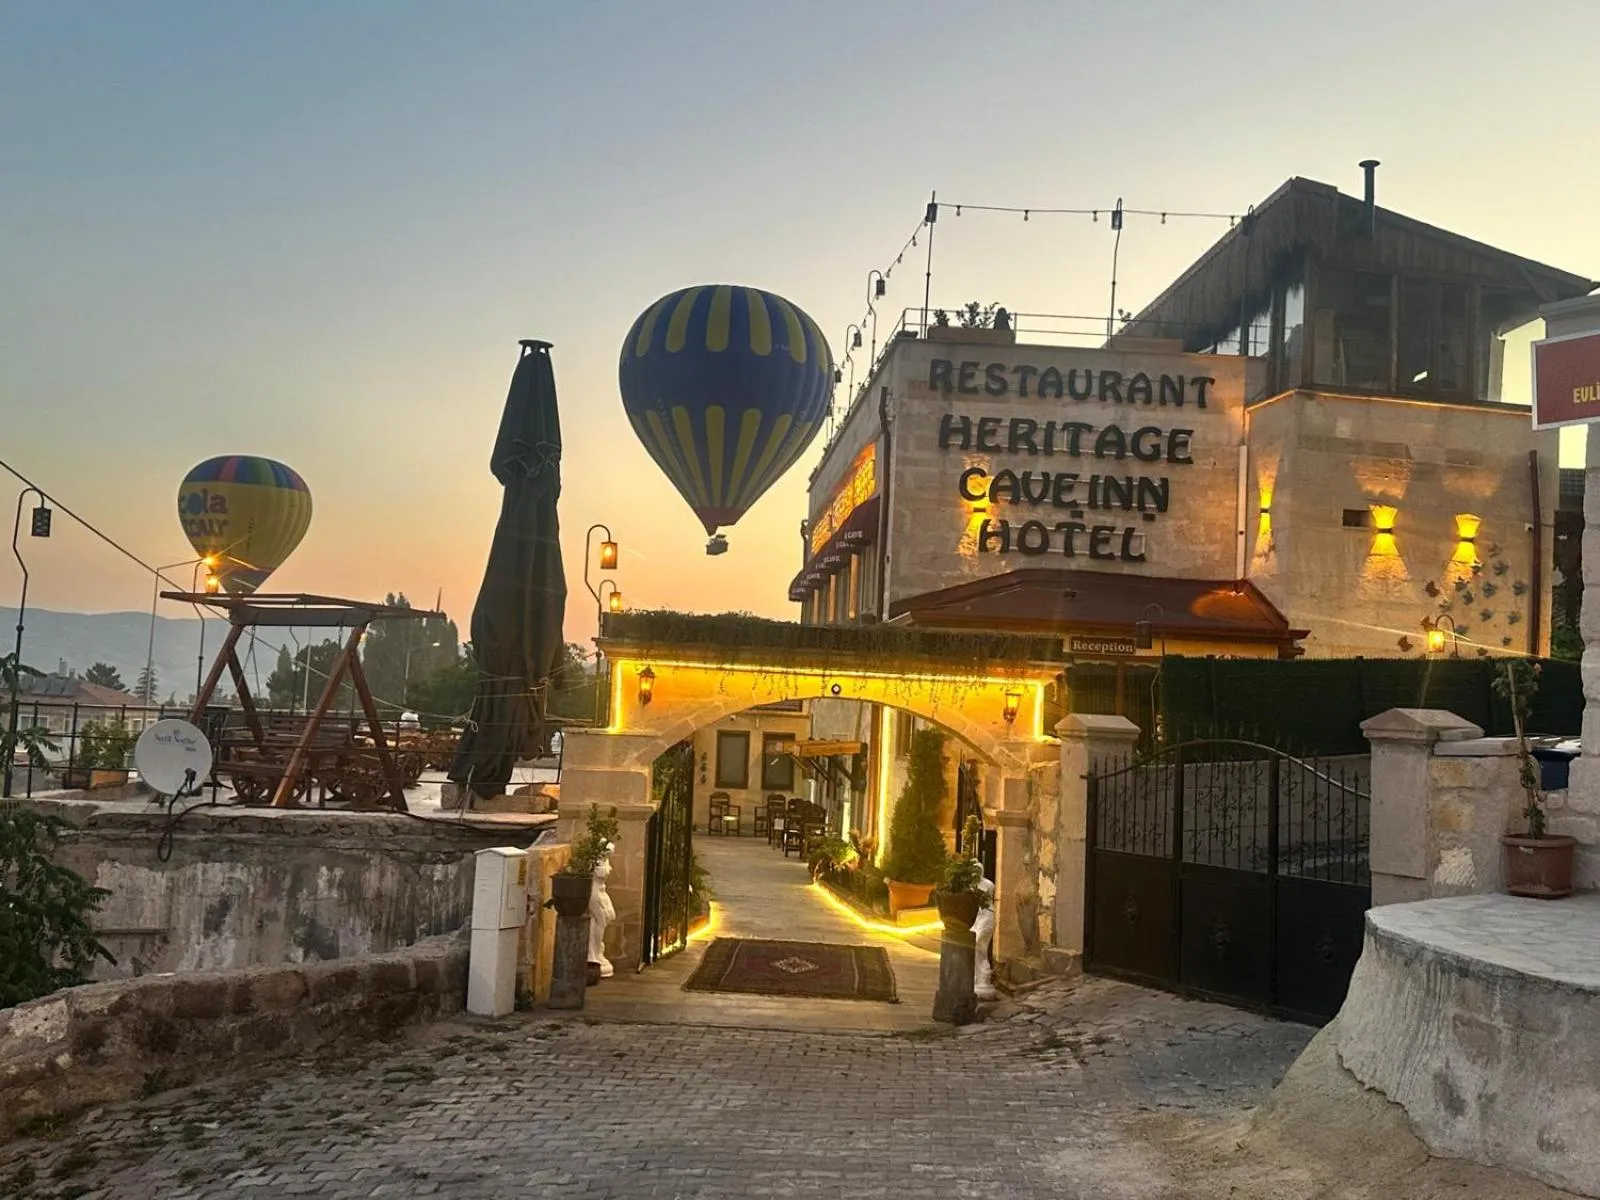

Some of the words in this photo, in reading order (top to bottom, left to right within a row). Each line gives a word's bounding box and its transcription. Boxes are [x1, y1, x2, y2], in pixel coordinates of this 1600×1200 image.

[929, 358, 1215, 408] RESTAURANT
[939, 413, 1194, 464] HERITAGE
[959, 468, 1079, 508] CAVE
[1089, 475, 1170, 513] INN
[978, 519, 1146, 562] HOTEL
[1073, 639, 1133, 653] Reception
